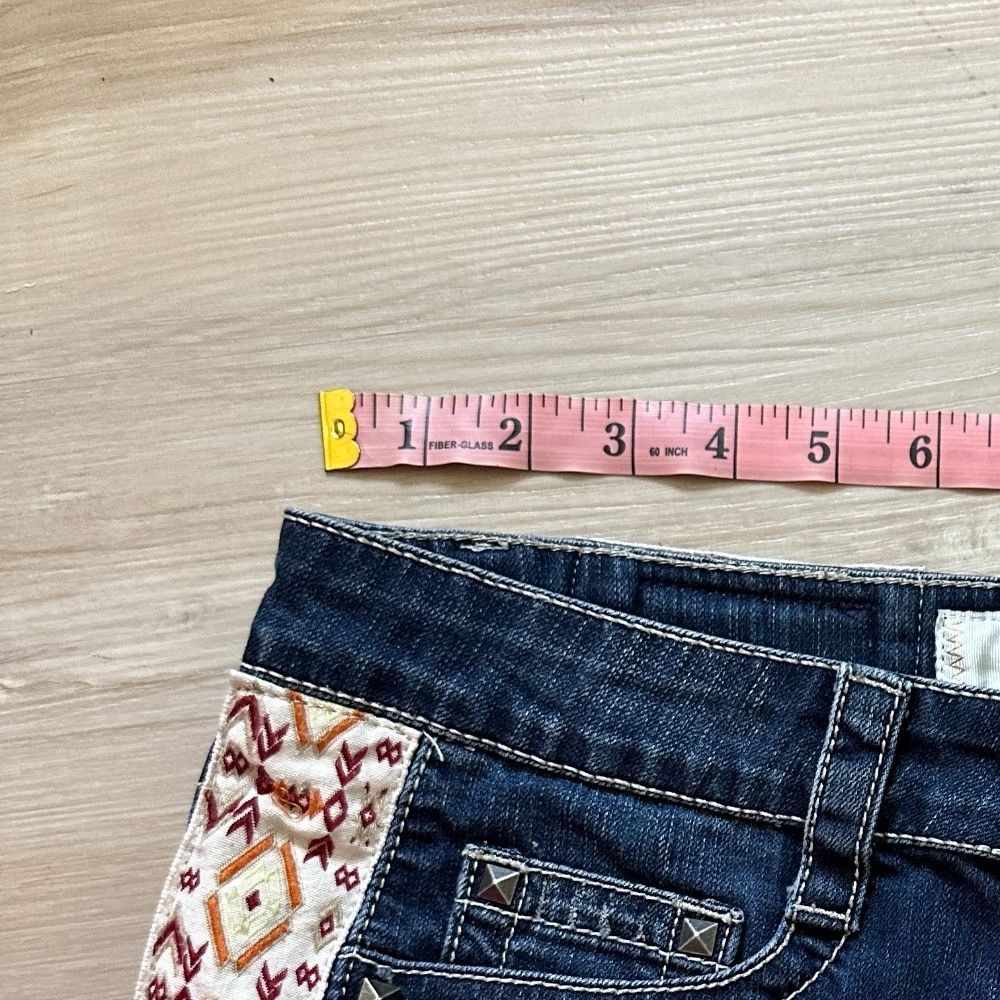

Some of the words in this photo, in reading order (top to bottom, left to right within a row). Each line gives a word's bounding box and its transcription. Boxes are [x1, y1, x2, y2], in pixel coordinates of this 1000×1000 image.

[398, 419, 416, 450] 1
[499, 417, 522, 452] 2
[603, 422, 627, 457] 3
[705, 426, 730, 460] 4
[807, 430, 831, 464] 5
[909, 435, 933, 469] 6
[428, 440, 494, 451] FIBER-GLASS
[649, 446, 661, 457] 60
[664, 446, 688, 457] INCH
